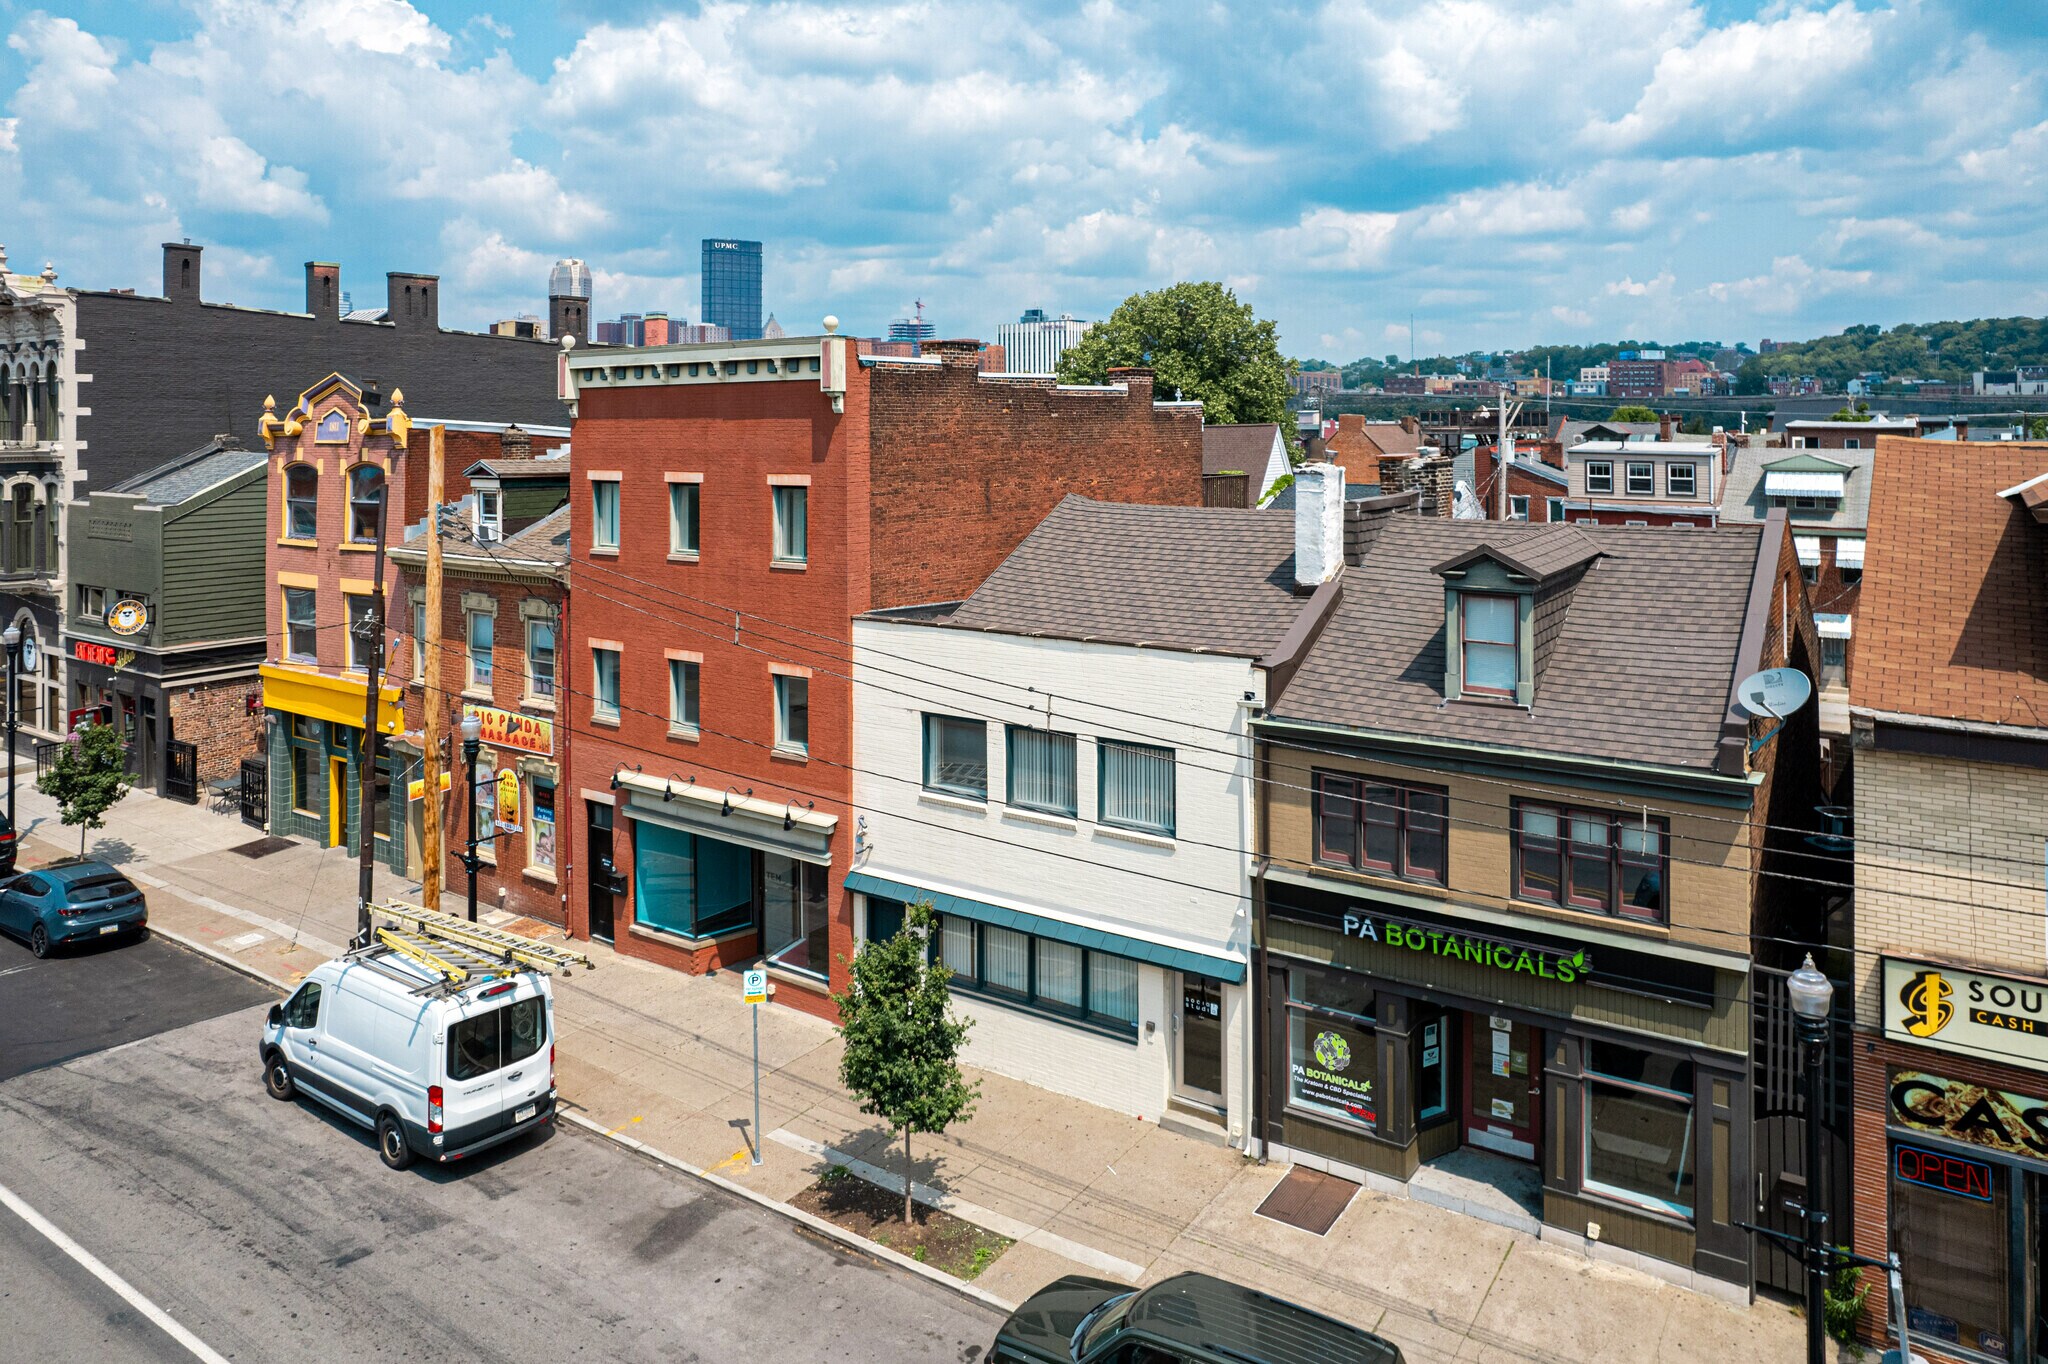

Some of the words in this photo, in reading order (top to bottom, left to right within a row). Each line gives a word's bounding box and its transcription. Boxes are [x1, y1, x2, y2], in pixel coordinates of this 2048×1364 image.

[113, 622, 141, 633] SALOON
[75, 641, 87, 661] FAT
[499, 714, 541, 737] PNDA
[1343, 913, 1378, 942] PA
[1385, 921, 1576, 983] BOTANICALS
[1976, 1011, 2034, 1033] CASH
[1292, 1063, 1305, 1076] PA
[1306, 1067, 1368, 1092] BOTANICALS
[1293, 1075, 1304, 1083] The
[1304, 1077, 1323, 1088] Kratom
[1329, 1085, 1342, 1093] CBD
[1342, 1089, 1372, 1102] Specialists
[1344, 1103, 1376, 1122] OPEN
[1899, 1149, 1990, 1198] OPEN
[1984, 1337, 2005, 1351] ADT
